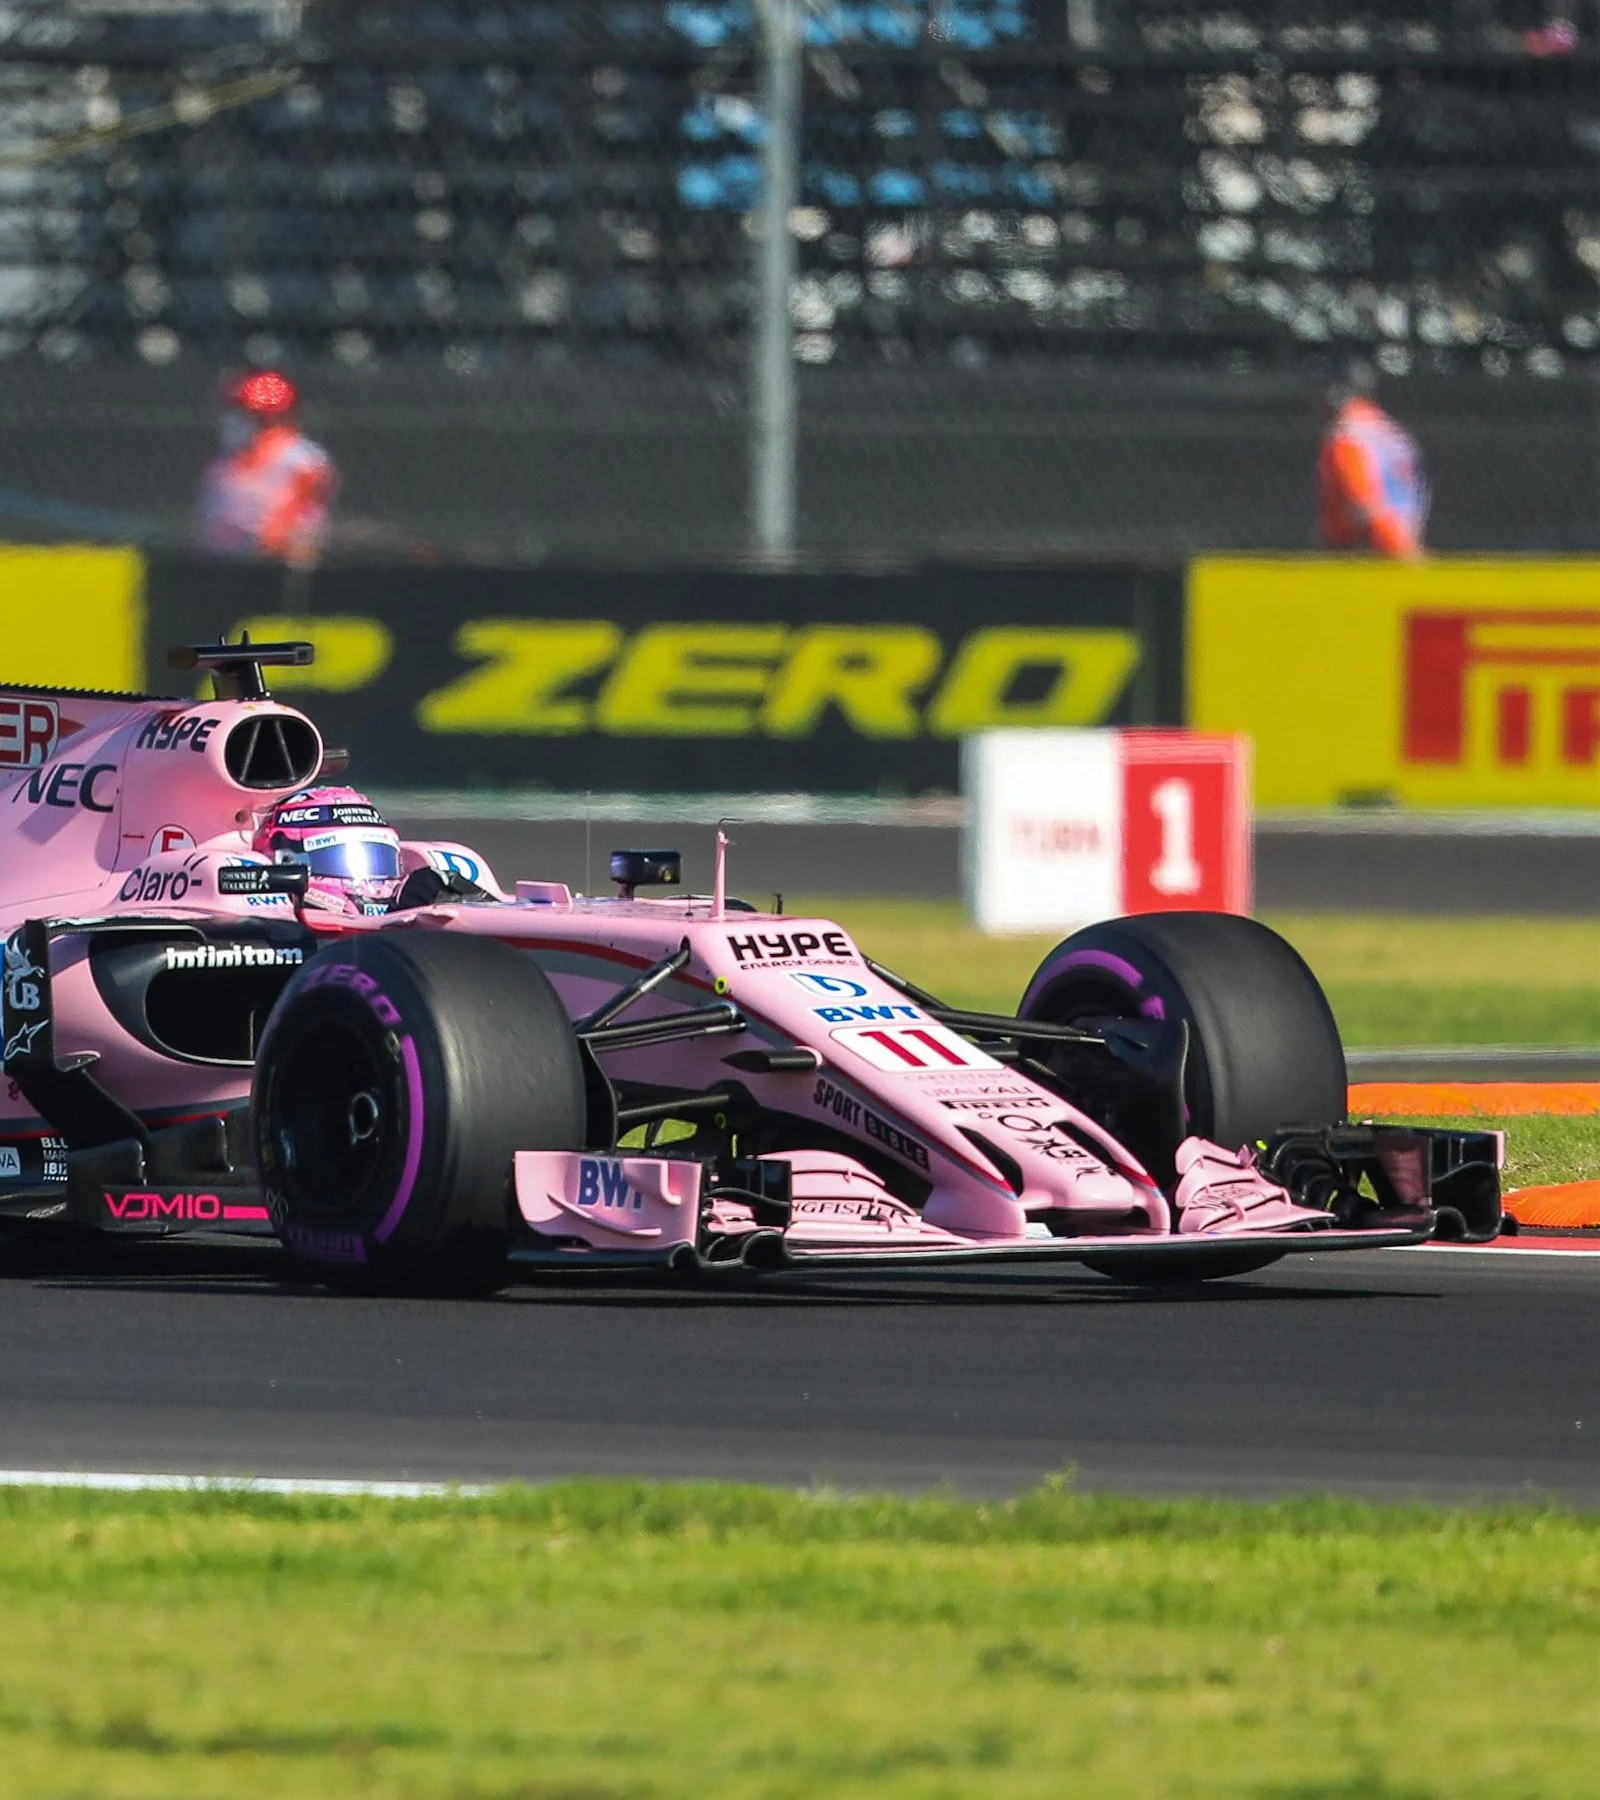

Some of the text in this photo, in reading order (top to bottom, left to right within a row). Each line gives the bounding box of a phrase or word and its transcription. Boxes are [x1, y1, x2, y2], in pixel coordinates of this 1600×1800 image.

[414, 617, 1142, 738] ZERO
[136, 714, 222, 753] HYPE
[12, 763, 118, 813] NEC
[278, 807, 321, 825] NEC
[1150, 777, 1204, 895] 1
[119, 866, 190, 902] Claro
[166, 944, 303, 970] infinitum
[727, 932, 854, 962] HYPE
[740, 960, 803, 970] ENERGY
[812, 1005, 922, 1023] BWT
[858, 1029, 973, 1067] 11
[813, 1078, 863, 1130] SPORT
